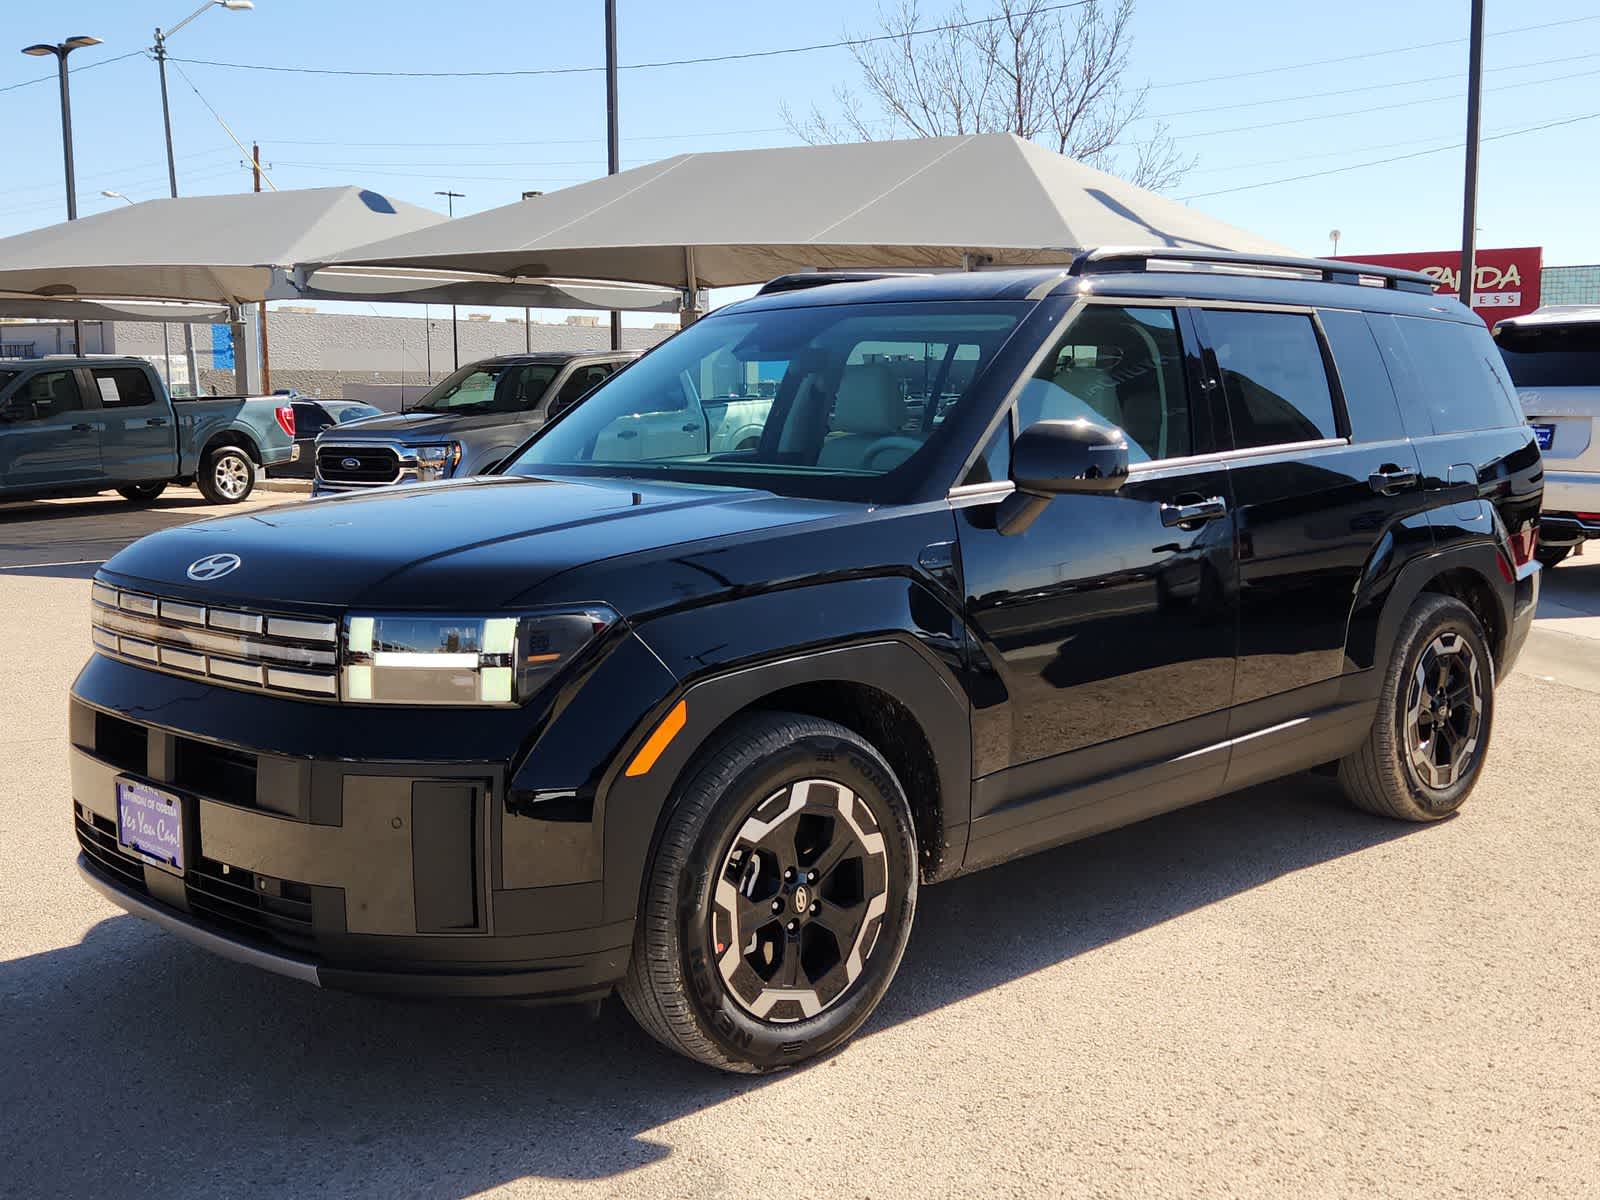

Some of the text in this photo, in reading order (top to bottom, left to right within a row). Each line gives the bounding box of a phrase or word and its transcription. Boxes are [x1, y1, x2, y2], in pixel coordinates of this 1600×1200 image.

[120, 805, 136, 831] Yes
[137, 811, 156, 836] You
[156, 818, 181, 848] Can!
